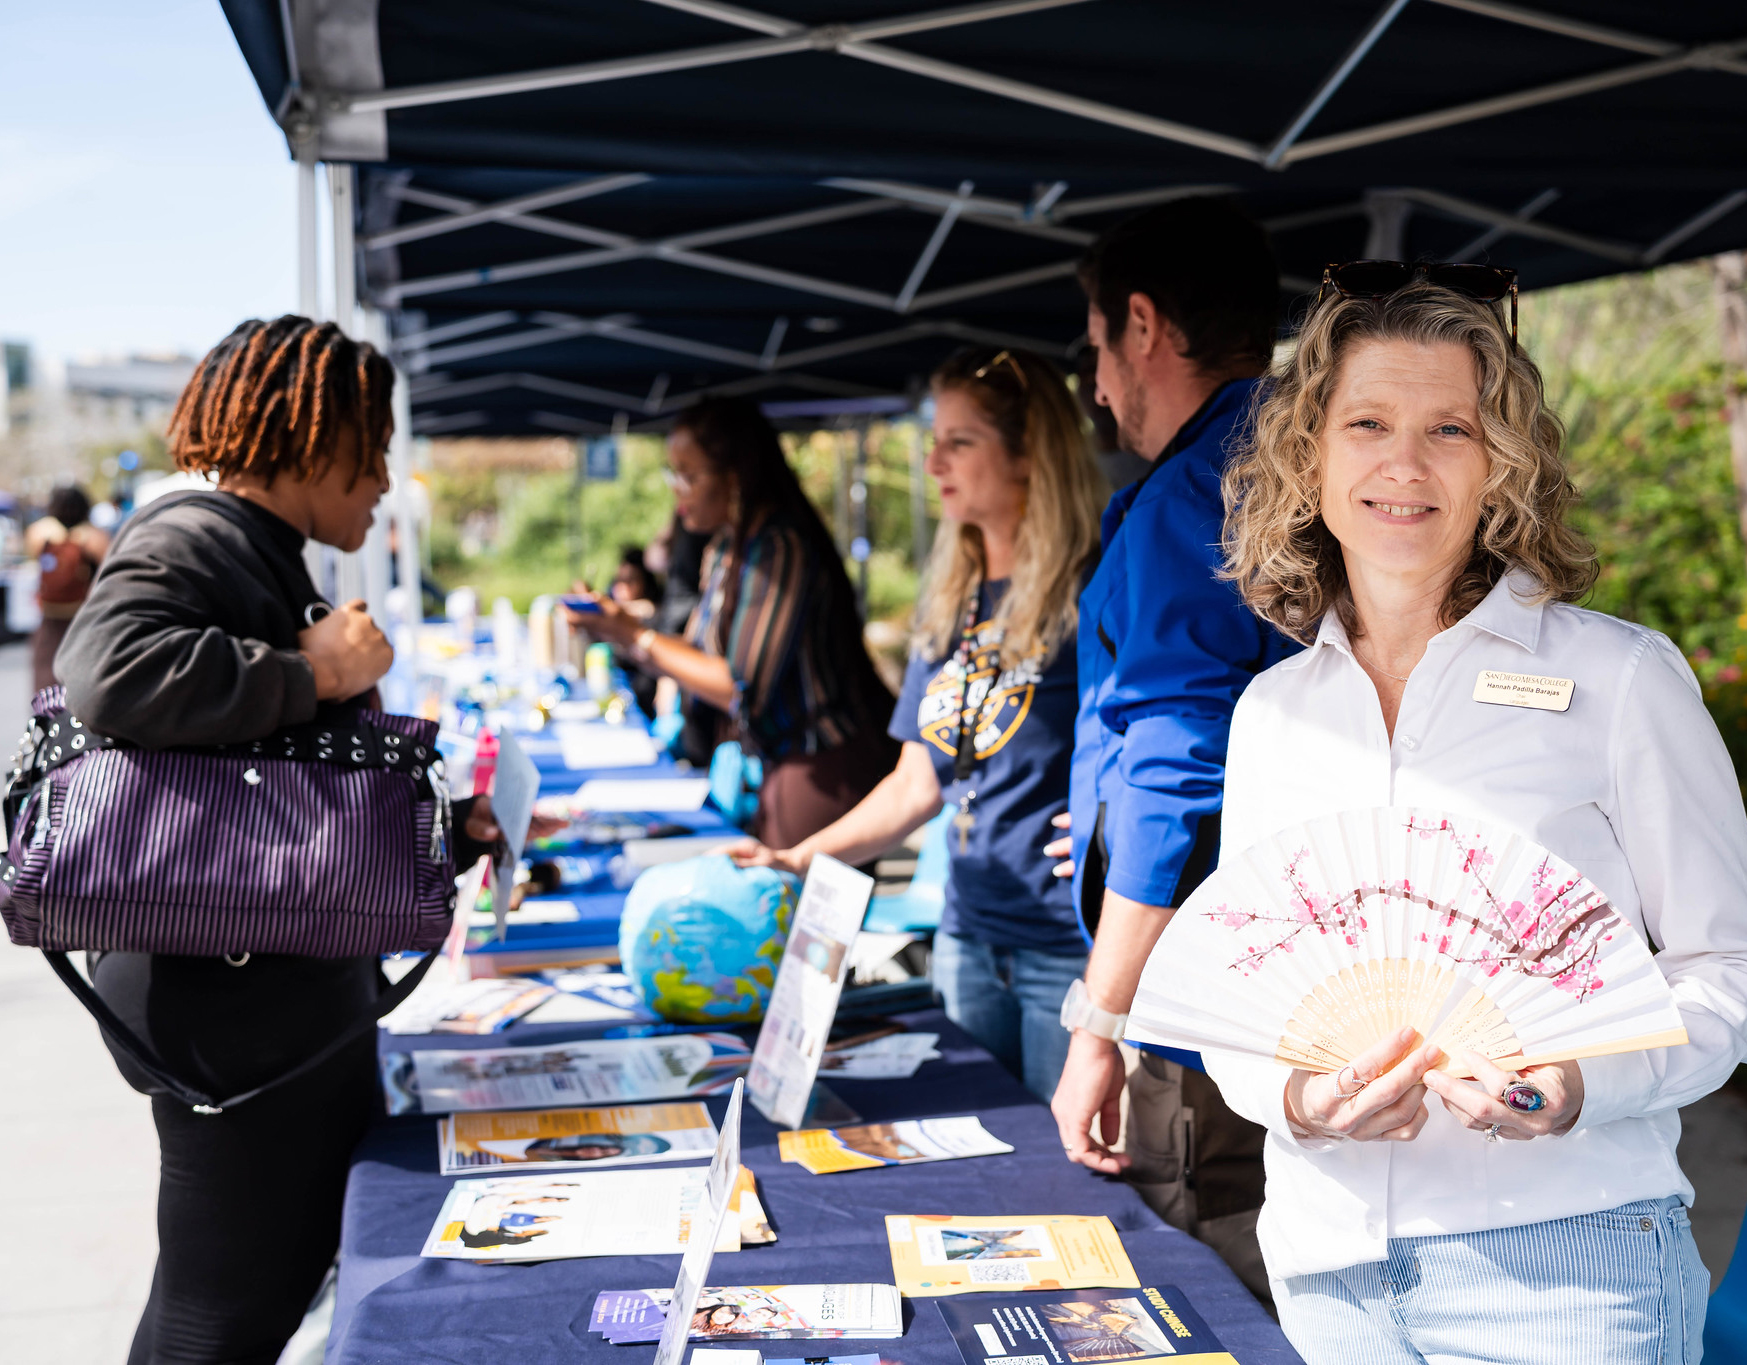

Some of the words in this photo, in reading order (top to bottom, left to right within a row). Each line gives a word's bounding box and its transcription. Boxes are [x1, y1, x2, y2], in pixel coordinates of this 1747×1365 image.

[1485, 672, 1499, 680] SAN
[1499, 673, 1521, 682] DIEGO
[1521, 676, 1539, 684] MESA
[1540, 678, 1568, 687] COLLEGE
[1486, 682, 1511, 690] Hannah
[1512, 685, 1534, 693] Padilla
[1535, 687, 1560, 696] Barajas
[1143, 1288, 1170, 1309] STUDY
[1159, 1309, 1192, 1338] CHINESE
